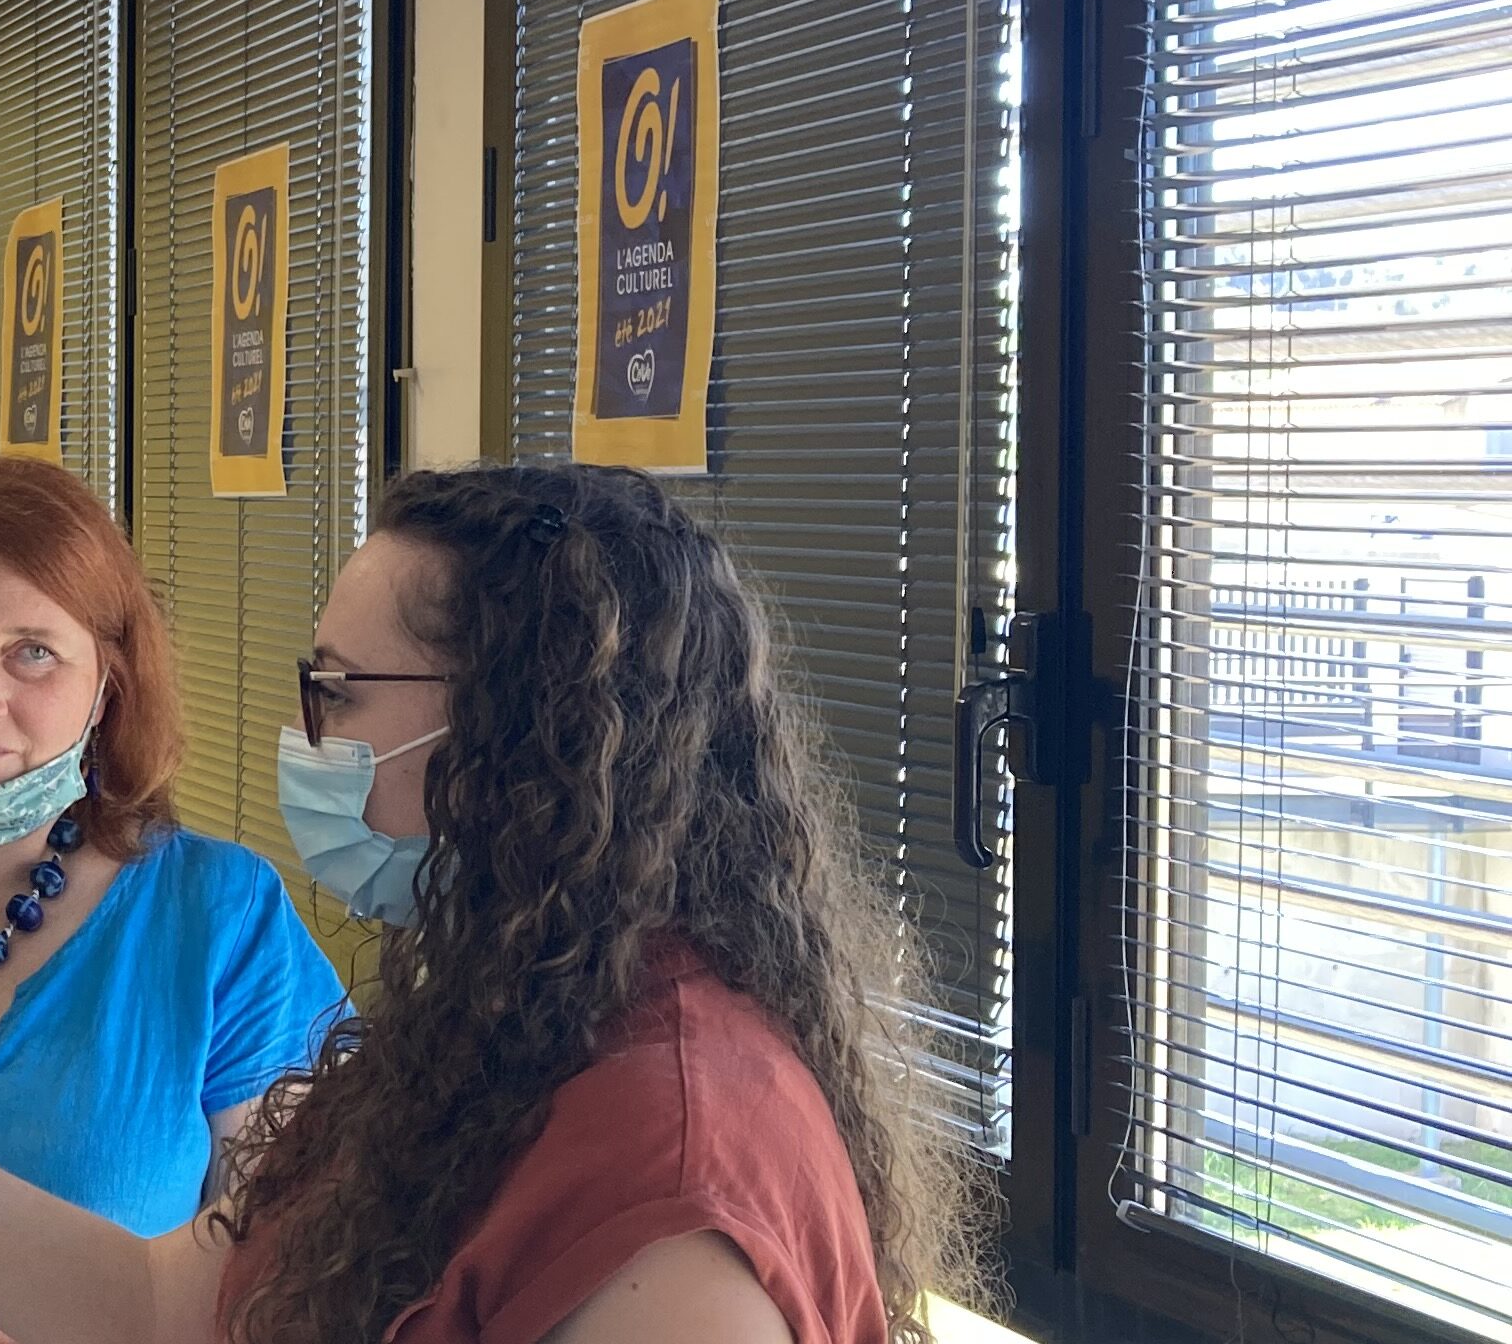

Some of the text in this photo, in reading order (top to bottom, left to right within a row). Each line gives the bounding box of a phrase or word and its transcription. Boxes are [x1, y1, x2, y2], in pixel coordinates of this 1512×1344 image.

[617, 240, 674, 271] L'AGENDA
[616, 267, 673, 296] CULTUREL
[614, 296, 672, 348] été 2021
[232, 329, 264, 349] L'AGENDA
[232, 349, 264, 367] CULTUREL
